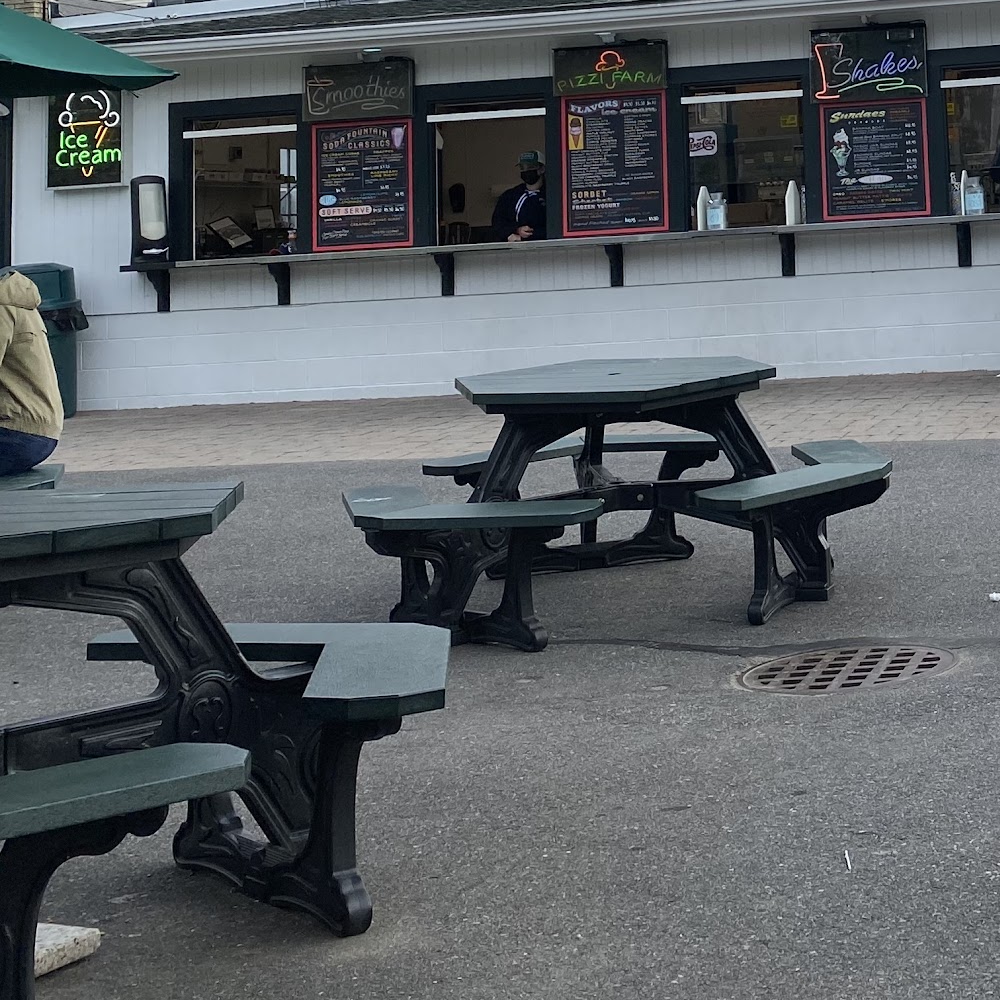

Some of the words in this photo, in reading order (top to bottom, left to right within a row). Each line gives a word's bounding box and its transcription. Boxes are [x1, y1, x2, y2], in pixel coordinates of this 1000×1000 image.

[827, 52, 922, 88] Shakes
[557, 73, 604, 92] PIZZI
[612, 70, 662, 85] FARM
[312, 75, 405, 111] Smoothies
[570, 100, 619, 114] FLAVORS
[829, 110, 886, 124] Sundaes
[60, 131, 88, 149] Ice
[323, 137, 345, 150] SODA
[347, 127, 388, 140] FOUNTAIN
[347, 140, 390, 149] CLASSICS
[56, 148, 122, 167] Cream
[572, 190, 607, 199] SORBET
[321, 208, 342, 216] SOFT
[344, 206, 370, 215] SERVE
